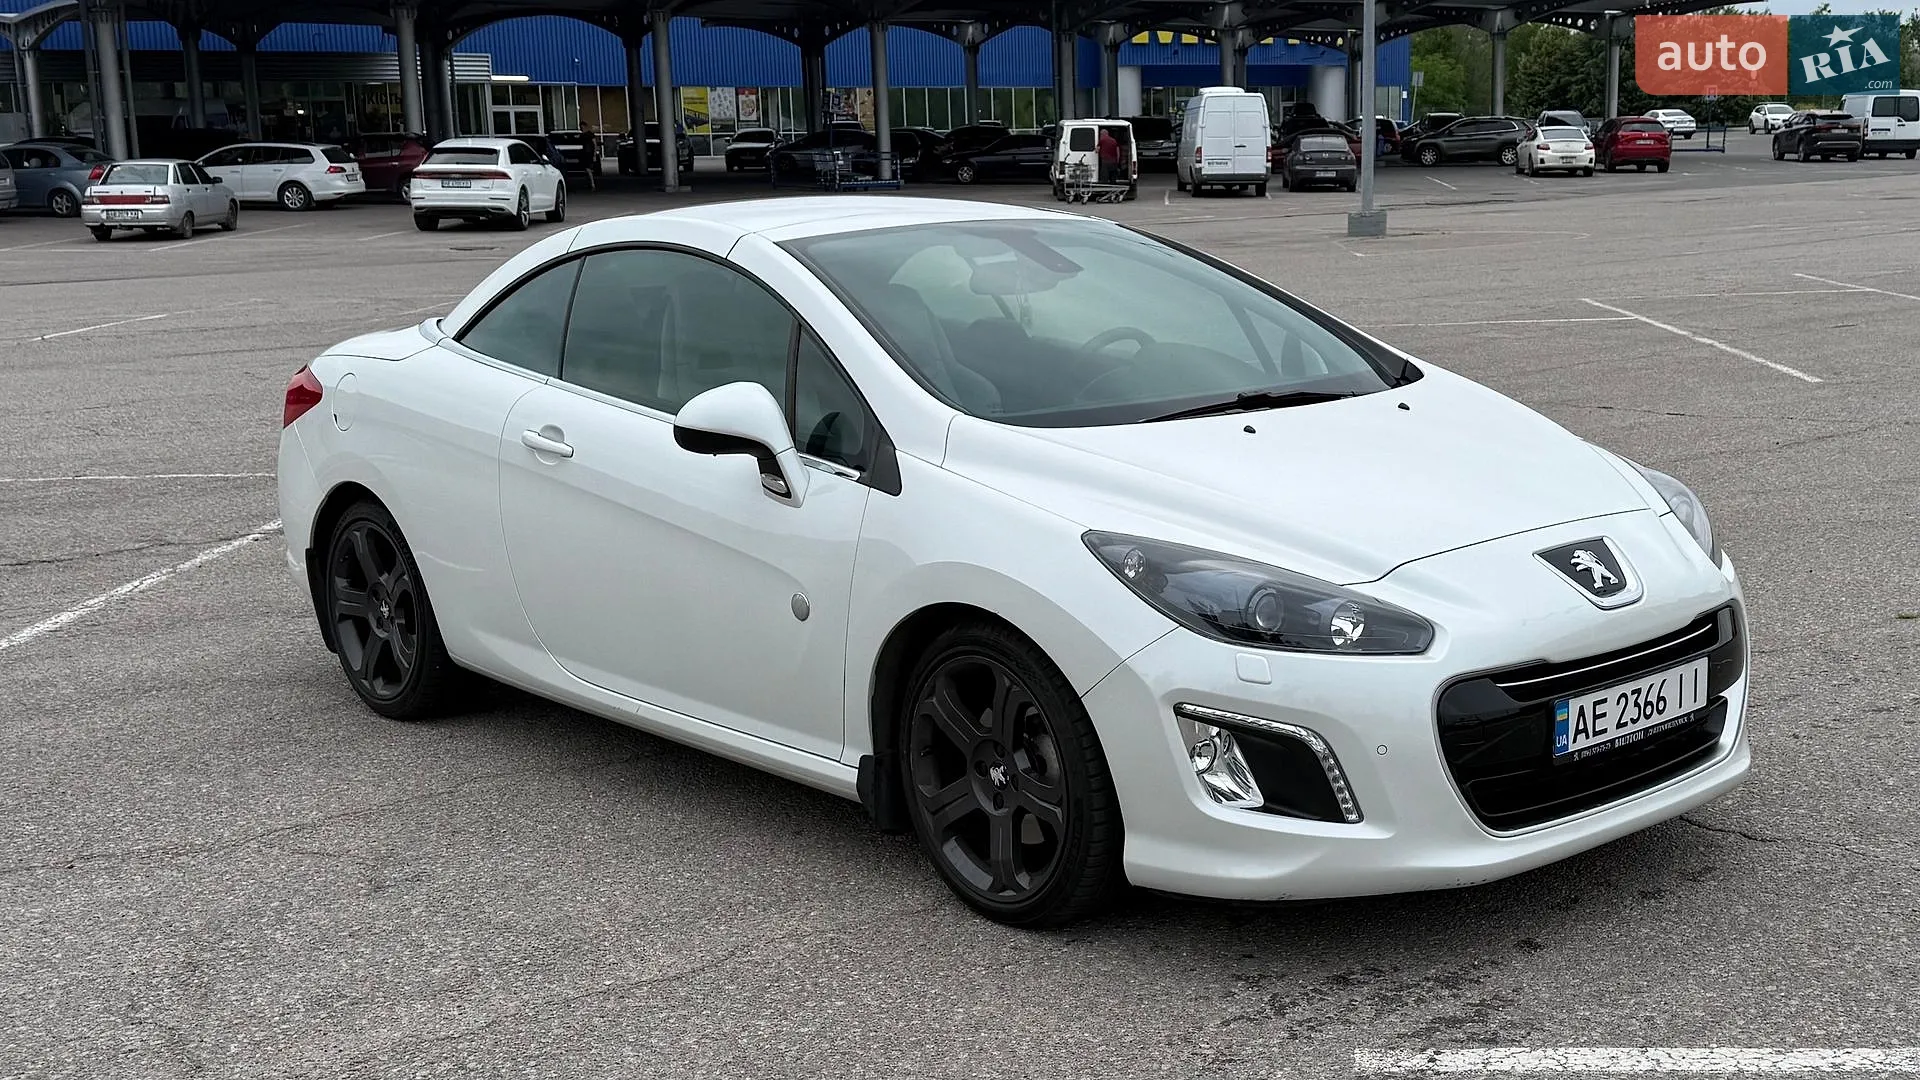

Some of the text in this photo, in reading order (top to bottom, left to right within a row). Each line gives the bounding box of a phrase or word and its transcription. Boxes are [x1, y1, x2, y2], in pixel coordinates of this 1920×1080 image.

[1572, 697, 1608, 744] AE
[1615, 678, 1667, 730] 2366
[1556, 735, 1568, 748] UA
